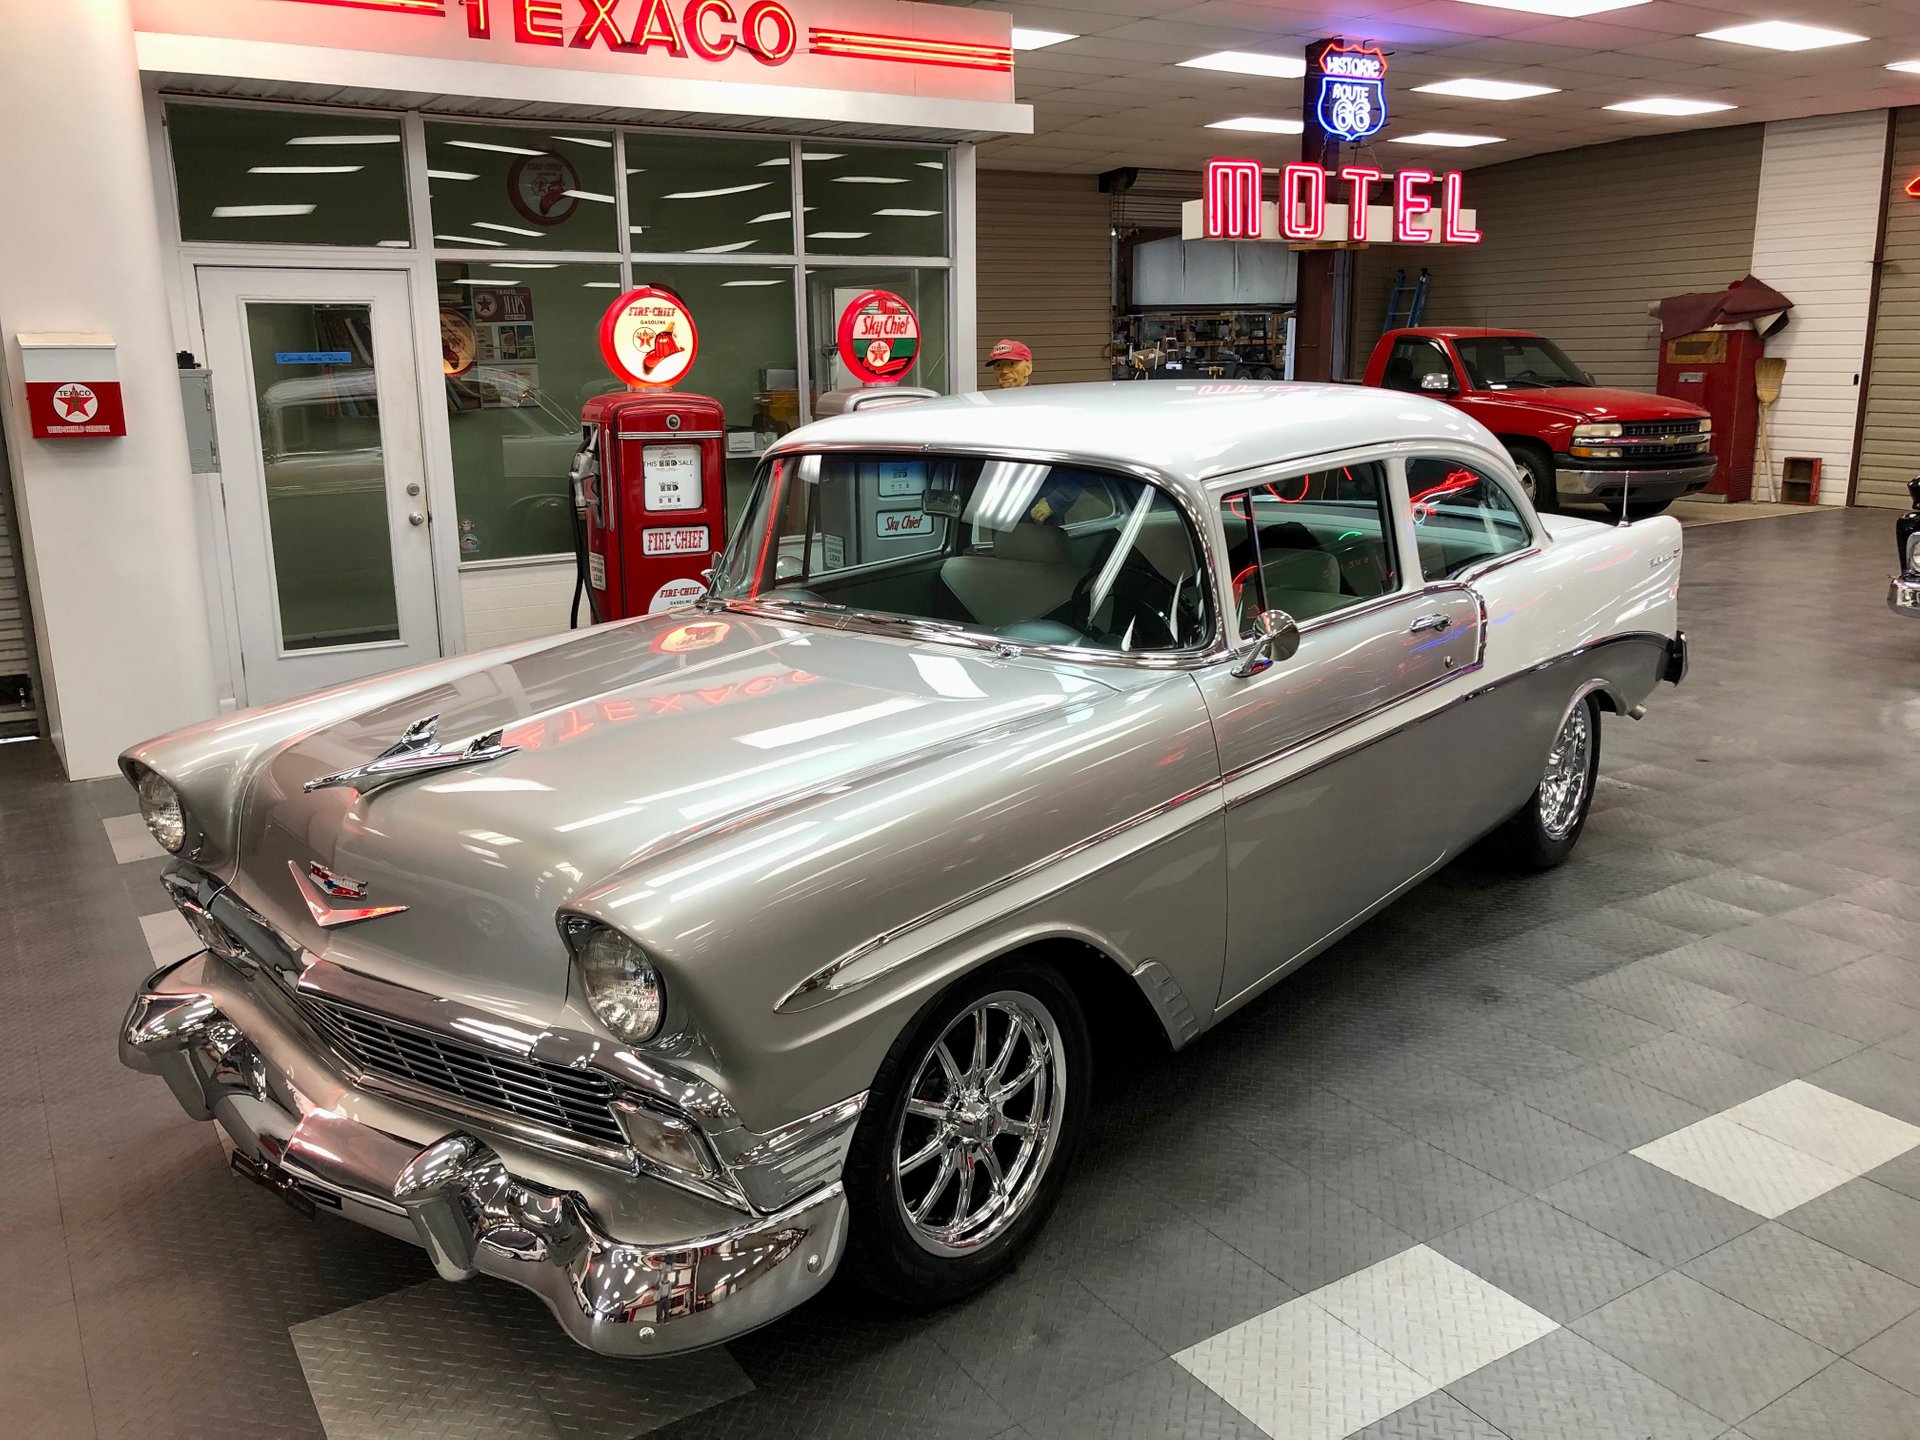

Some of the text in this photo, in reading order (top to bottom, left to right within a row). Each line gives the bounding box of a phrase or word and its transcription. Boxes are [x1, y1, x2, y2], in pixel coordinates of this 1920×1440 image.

[1332, 83, 1370, 101] ROUTE
[1333, 99, 1371, 132] 66
[1203, 157, 1483, 244] MOTEL
[496, 288, 517, 296] TRAVEL
[503, 295, 527, 314] MAPS
[628, 306, 677, 317] FIRE-CHIEF
[861, 315, 911, 338] Sky Chief
[884, 514, 924, 532] Sky Chief
[647, 530, 704, 552] FIRE-CHIEF
[660, 587, 702, 599] FIRE-CHIEF
